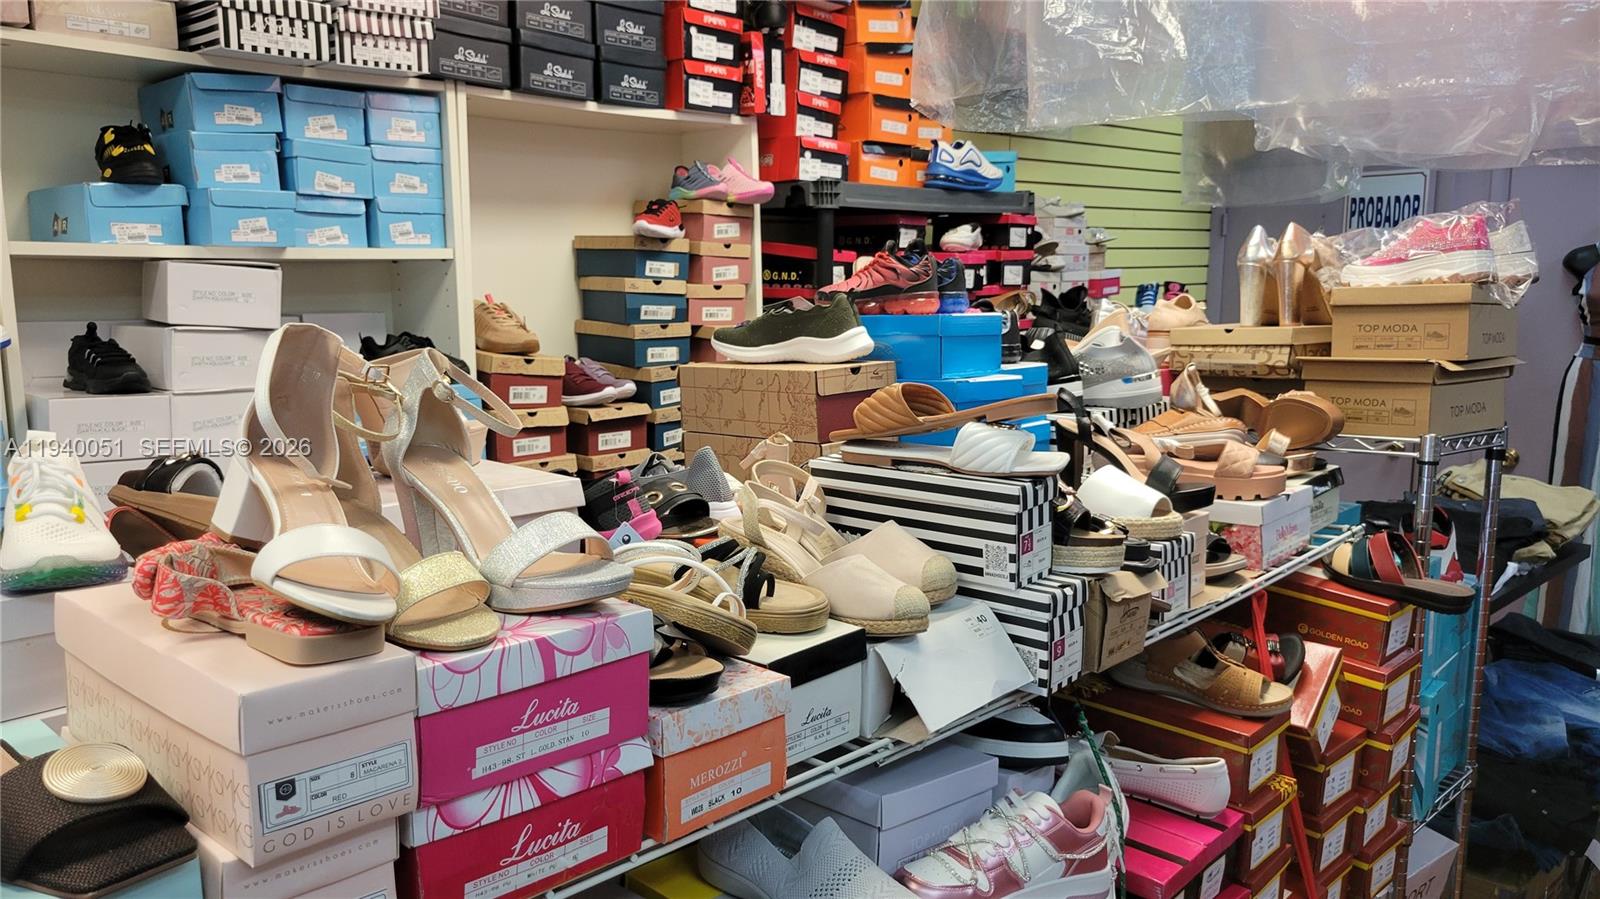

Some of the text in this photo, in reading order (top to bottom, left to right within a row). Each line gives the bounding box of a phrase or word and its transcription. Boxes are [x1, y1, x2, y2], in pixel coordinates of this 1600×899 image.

[1348, 194, 1421, 230] PROBADOR
[772, 271, 800, 281] G.N.D.
[1357, 323, 1418, 334] TOP MODA
[1330, 396, 1387, 408] TOP MODA
[1449, 401, 1487, 418] TOP MODA
[976, 613, 988, 625] 40
[1309, 627, 1369, 650] GOLDEN ROAD
[511, 697, 580, 733] Lucita
[534, 725, 558, 738] COLOR
[582, 713, 597, 724] SIZE
[801, 706, 832, 726] Lucita
[361, 759, 377, 769] STYLE
[690, 756, 743, 789] MEROZZI
[310, 791, 348, 803] COLOR RED
[708, 794, 725, 808] BLACK
[731, 787, 742, 797] 10
[263, 793, 412, 854] GOD IS LOVE
[500, 818, 581, 866] Lucita
[530, 852, 555, 867] COLOR
[580, 834, 594, 846] SIZE
